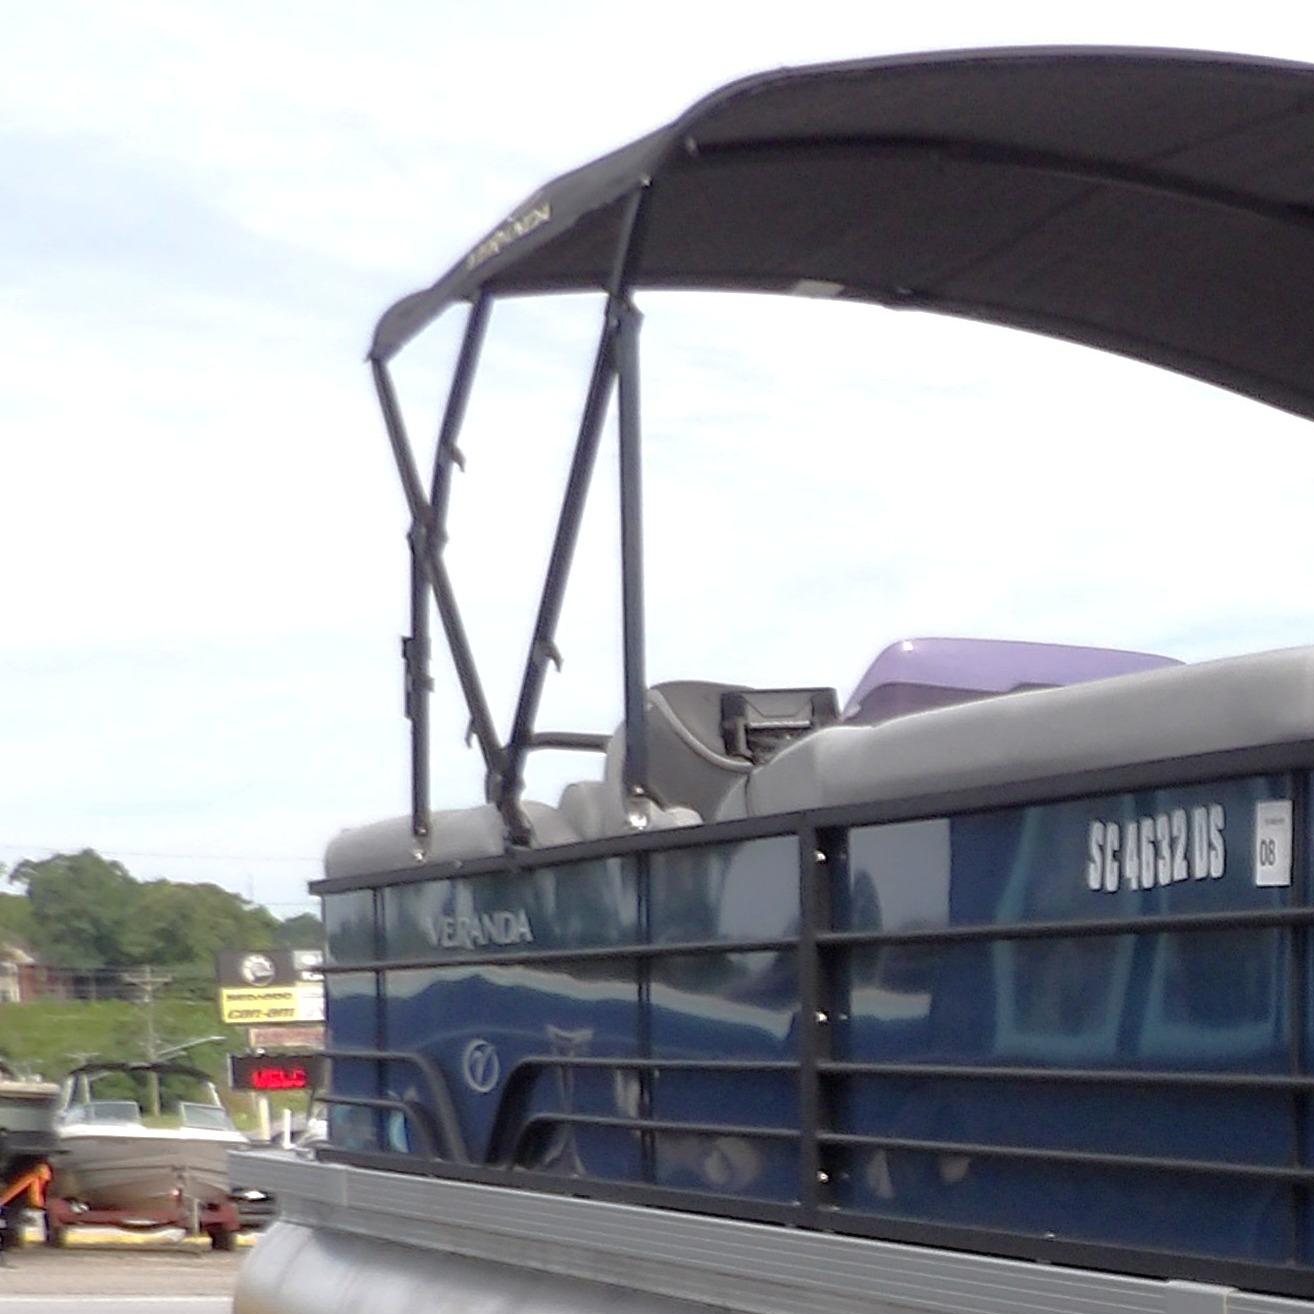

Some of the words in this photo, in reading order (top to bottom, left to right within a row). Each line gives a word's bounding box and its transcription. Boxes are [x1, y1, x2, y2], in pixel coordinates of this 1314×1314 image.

[1088, 820, 1121, 892] SC
[1125, 807, 1189, 891] 4632
[1259, 838, 1276, 867] 08
[427, 908, 534, 950] VERANDA
